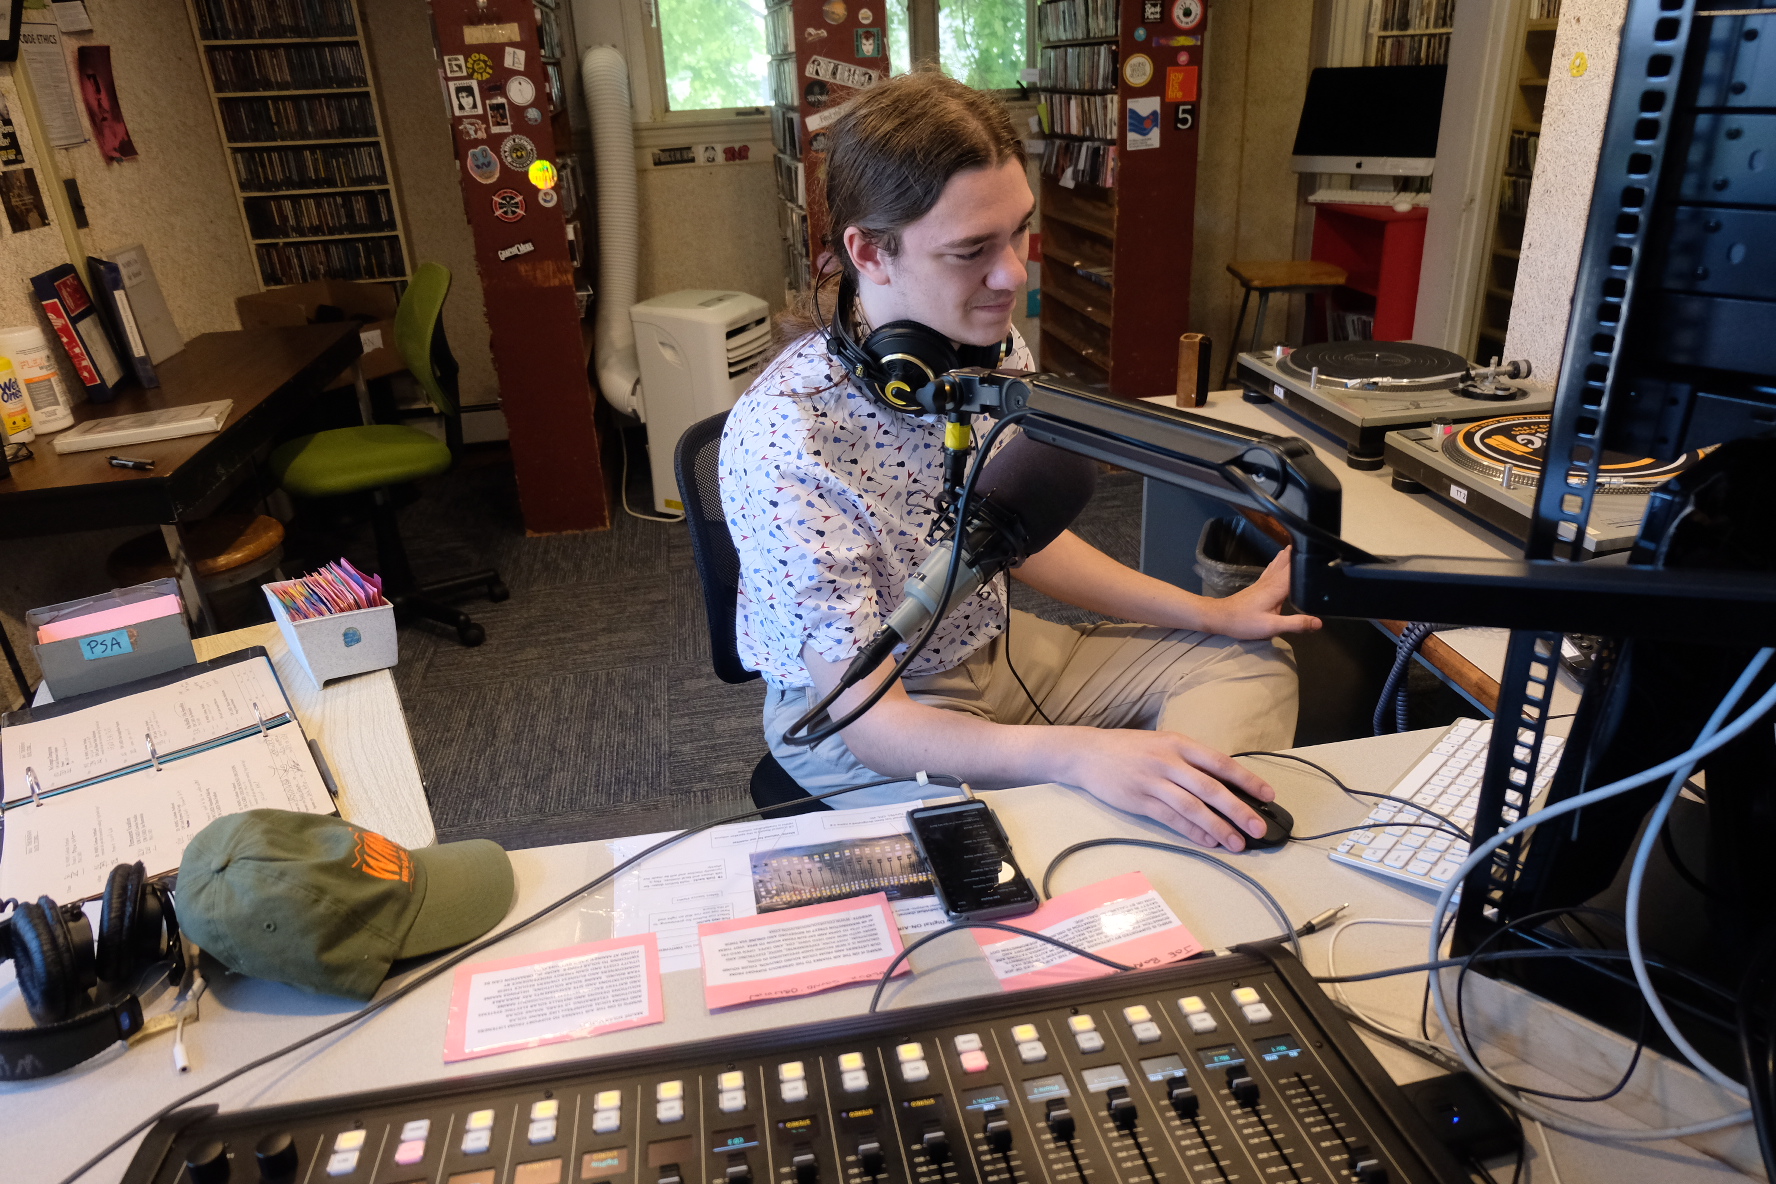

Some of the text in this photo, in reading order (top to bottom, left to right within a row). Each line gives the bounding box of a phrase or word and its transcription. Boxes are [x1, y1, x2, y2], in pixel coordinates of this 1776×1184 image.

[1176, 105, 1192, 130] 5
[86, 636, 123, 656] PSA
[1167, 944, 1194, 958] JOE
